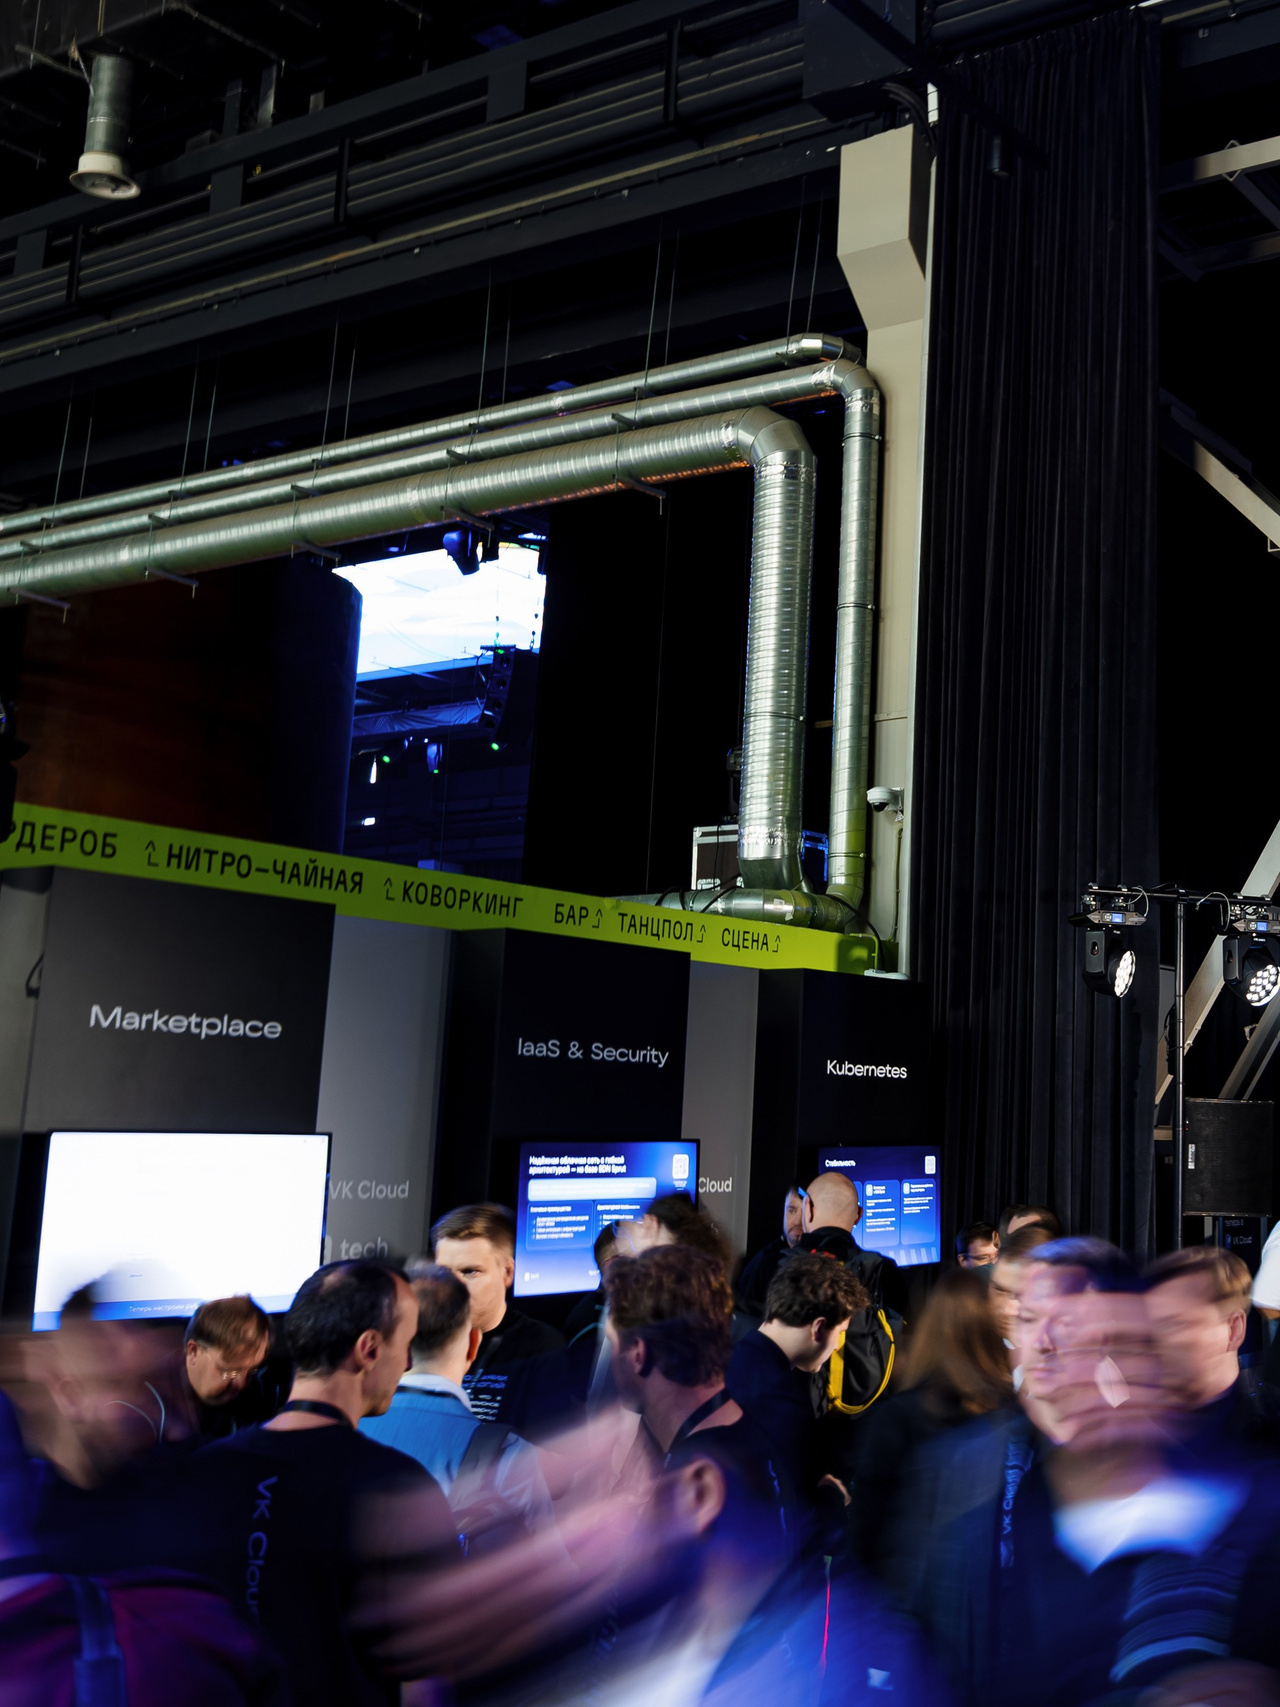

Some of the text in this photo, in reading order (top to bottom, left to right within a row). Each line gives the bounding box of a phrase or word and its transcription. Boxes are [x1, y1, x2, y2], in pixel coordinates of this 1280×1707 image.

[402, 879, 523, 918] КОВОРКИНГ
[553, 902, 590, 927] БАР
[618, 911, 695, 943] ТАНЦПОЛ
[721, 927, 770, 952] СЦЕНА
[89, 1004, 282, 1040] Marketplace
[518, 1037, 669, 1068] IaaS & Security
[826, 1059, 908, 1079] Kubernetes
[329, 1179, 409, 1199] VK Cloud
[699, 1177, 732, 1193] Cloud
[340, 1236, 389, 1260] tech
[253, 1475, 278, 1519] VK
